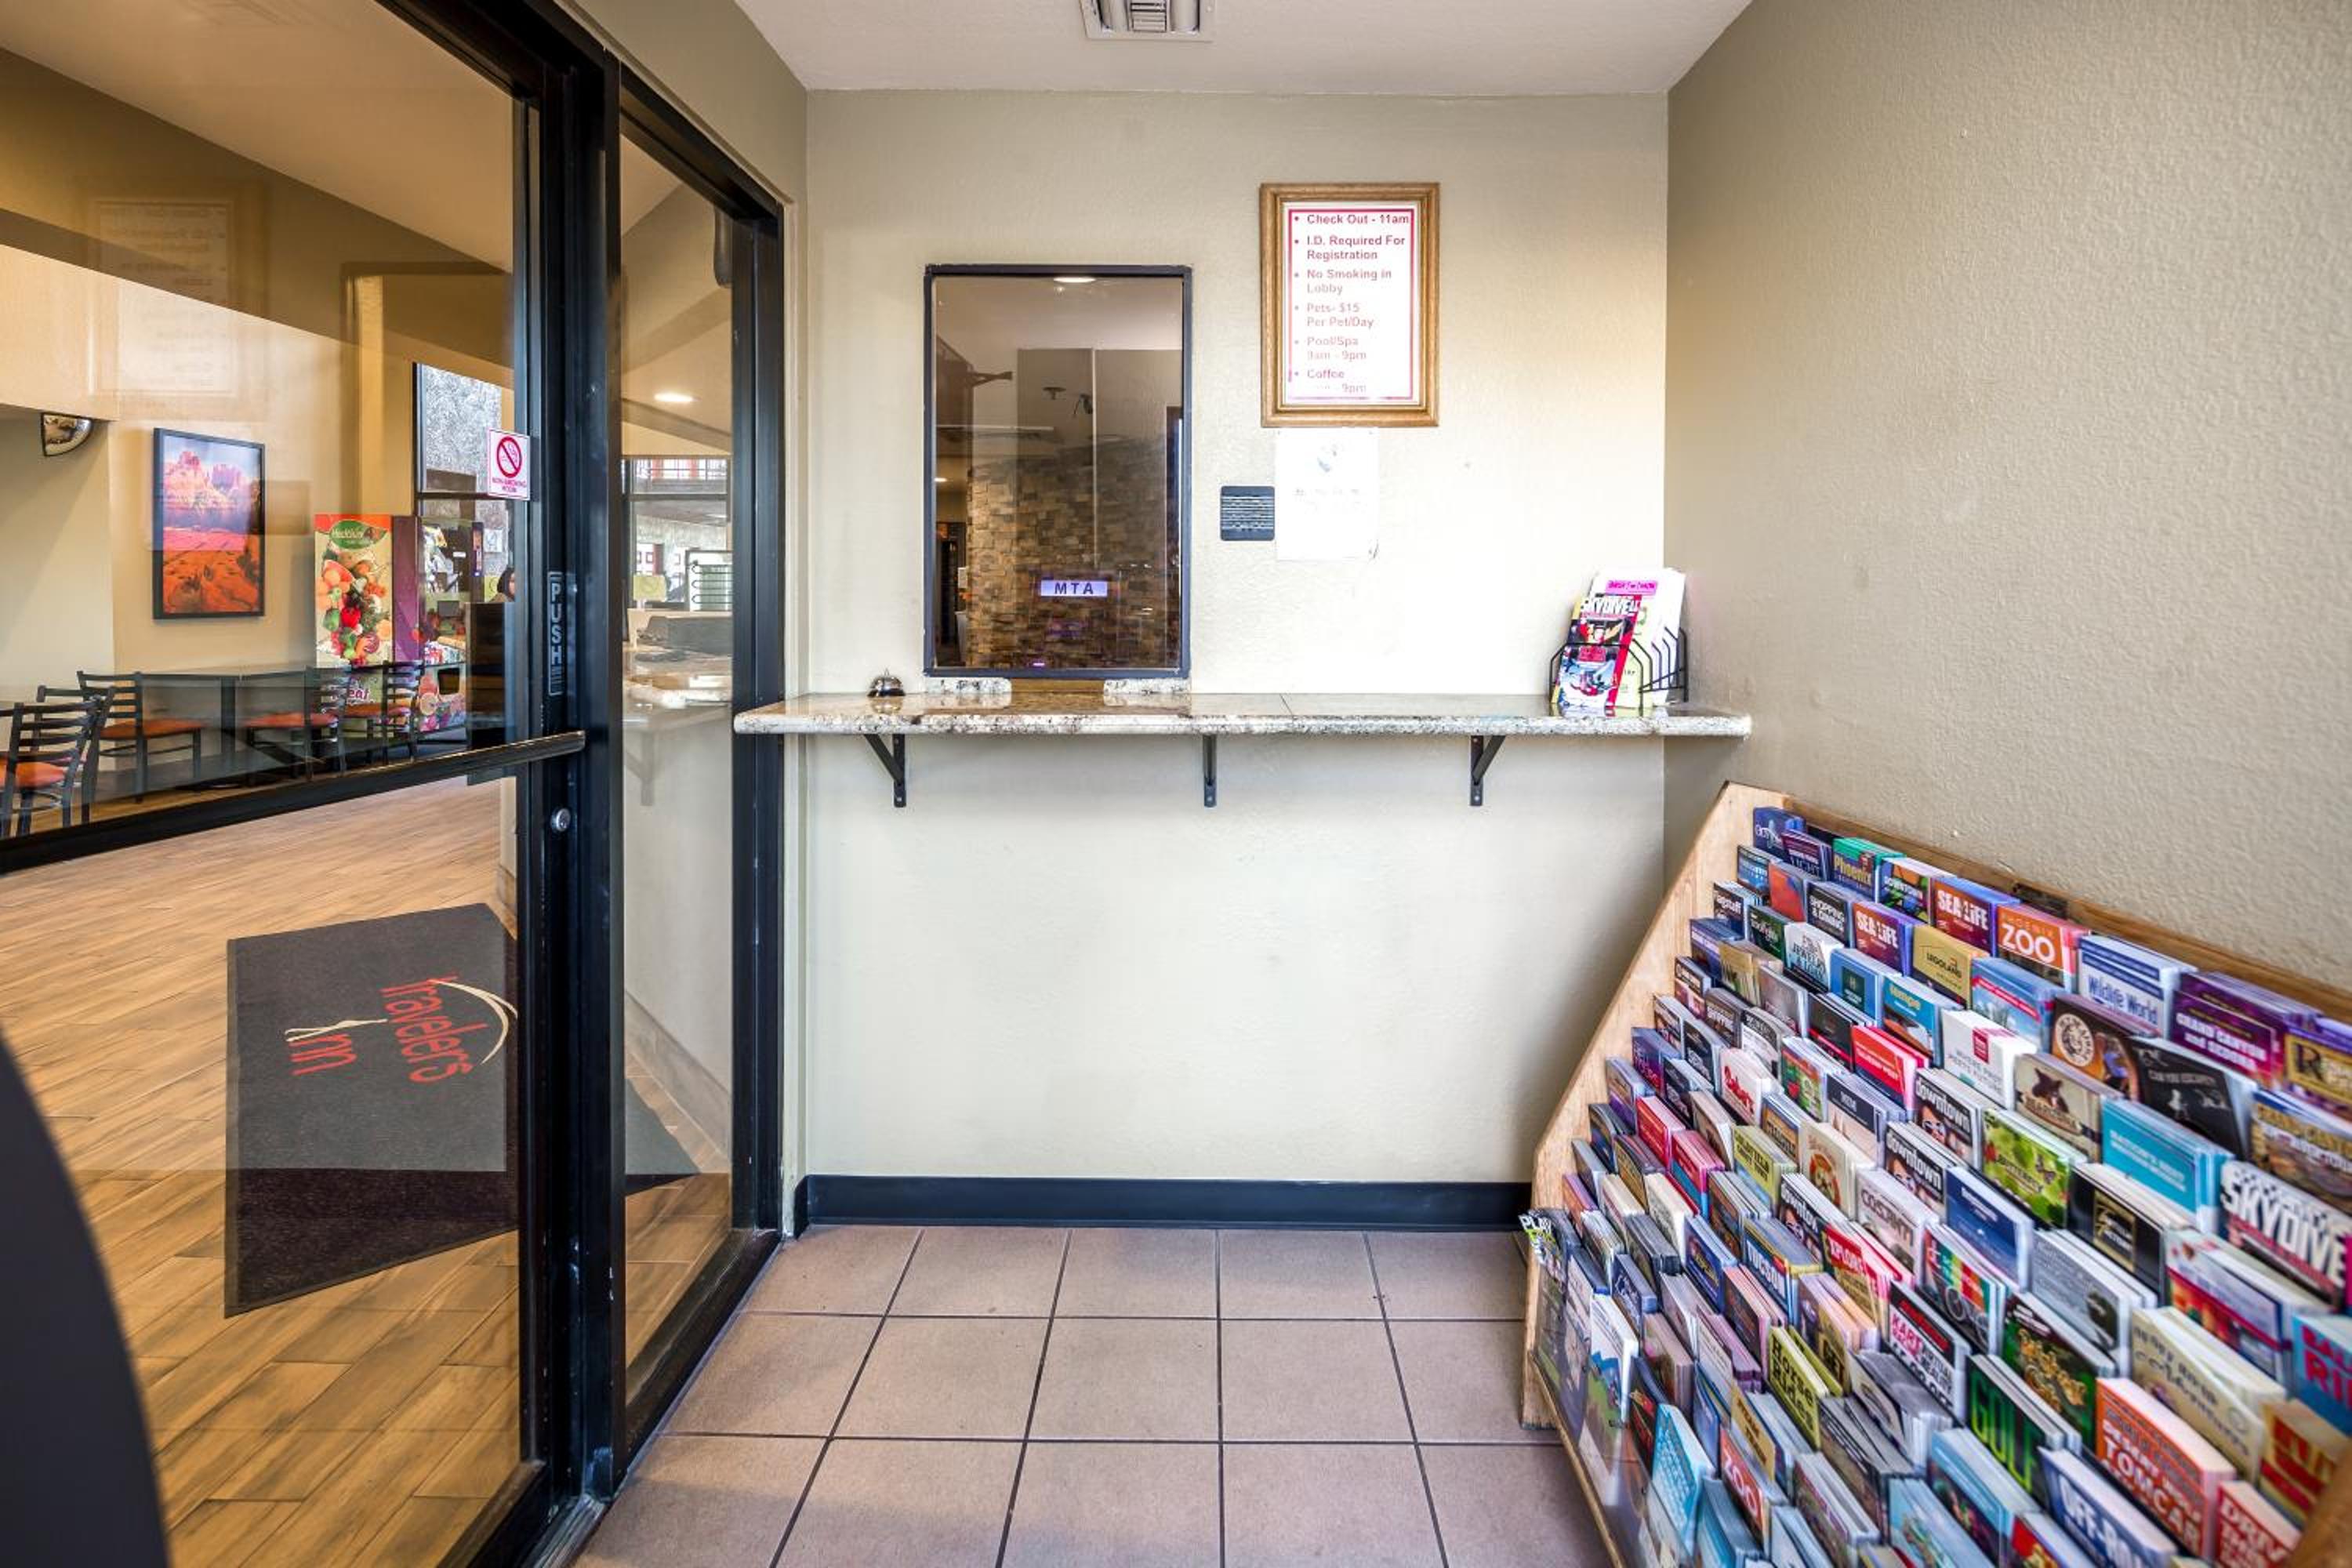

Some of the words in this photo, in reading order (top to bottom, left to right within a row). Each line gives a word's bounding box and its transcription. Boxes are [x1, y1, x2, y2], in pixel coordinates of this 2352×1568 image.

[1306, 214, 1344, 225] Check
[1347, 214, 1368, 225] Out
[1379, 214, 1410, 225] 11am
[1306, 235, 1327, 246] I.D.
[1329, 235, 1383, 249] Required
[1385, 235, 1406, 246] For
[1306, 249, 1378, 262] Registration
[1306, 269, 1323, 279] No
[1326, 269, 1378, 281] Smoking
[1381, 269, 1392, 279] in
[1306, 283, 1343, 294] Lobby
[1338, 303, 1360, 314] $15
[1306, 317, 1327, 328] Per
[1329, 317, 1374, 329] Pet/Day
[1306, 336, 1359, 347] Pool/Spa
[1306, 368, 1345, 379] Coffee
[550, 583, 563, 666] PUSH
[1936, 889, 1962, 919] SEA
[1856, 910, 1876, 937] SEA
[2001, 923, 2056, 964] ZOO
[2127, 993, 2158, 1025] World
[2176, 1011, 2215, 1039] GRAND
[2216, 1028, 2267, 1062] CANYON
[2184, 1031, 2206, 1050] and
[2219, 1176, 2346, 1290] SKYDIVE
[1892, 1312, 1925, 1350] KART
[1771, 1333, 1813, 1408] Horse
